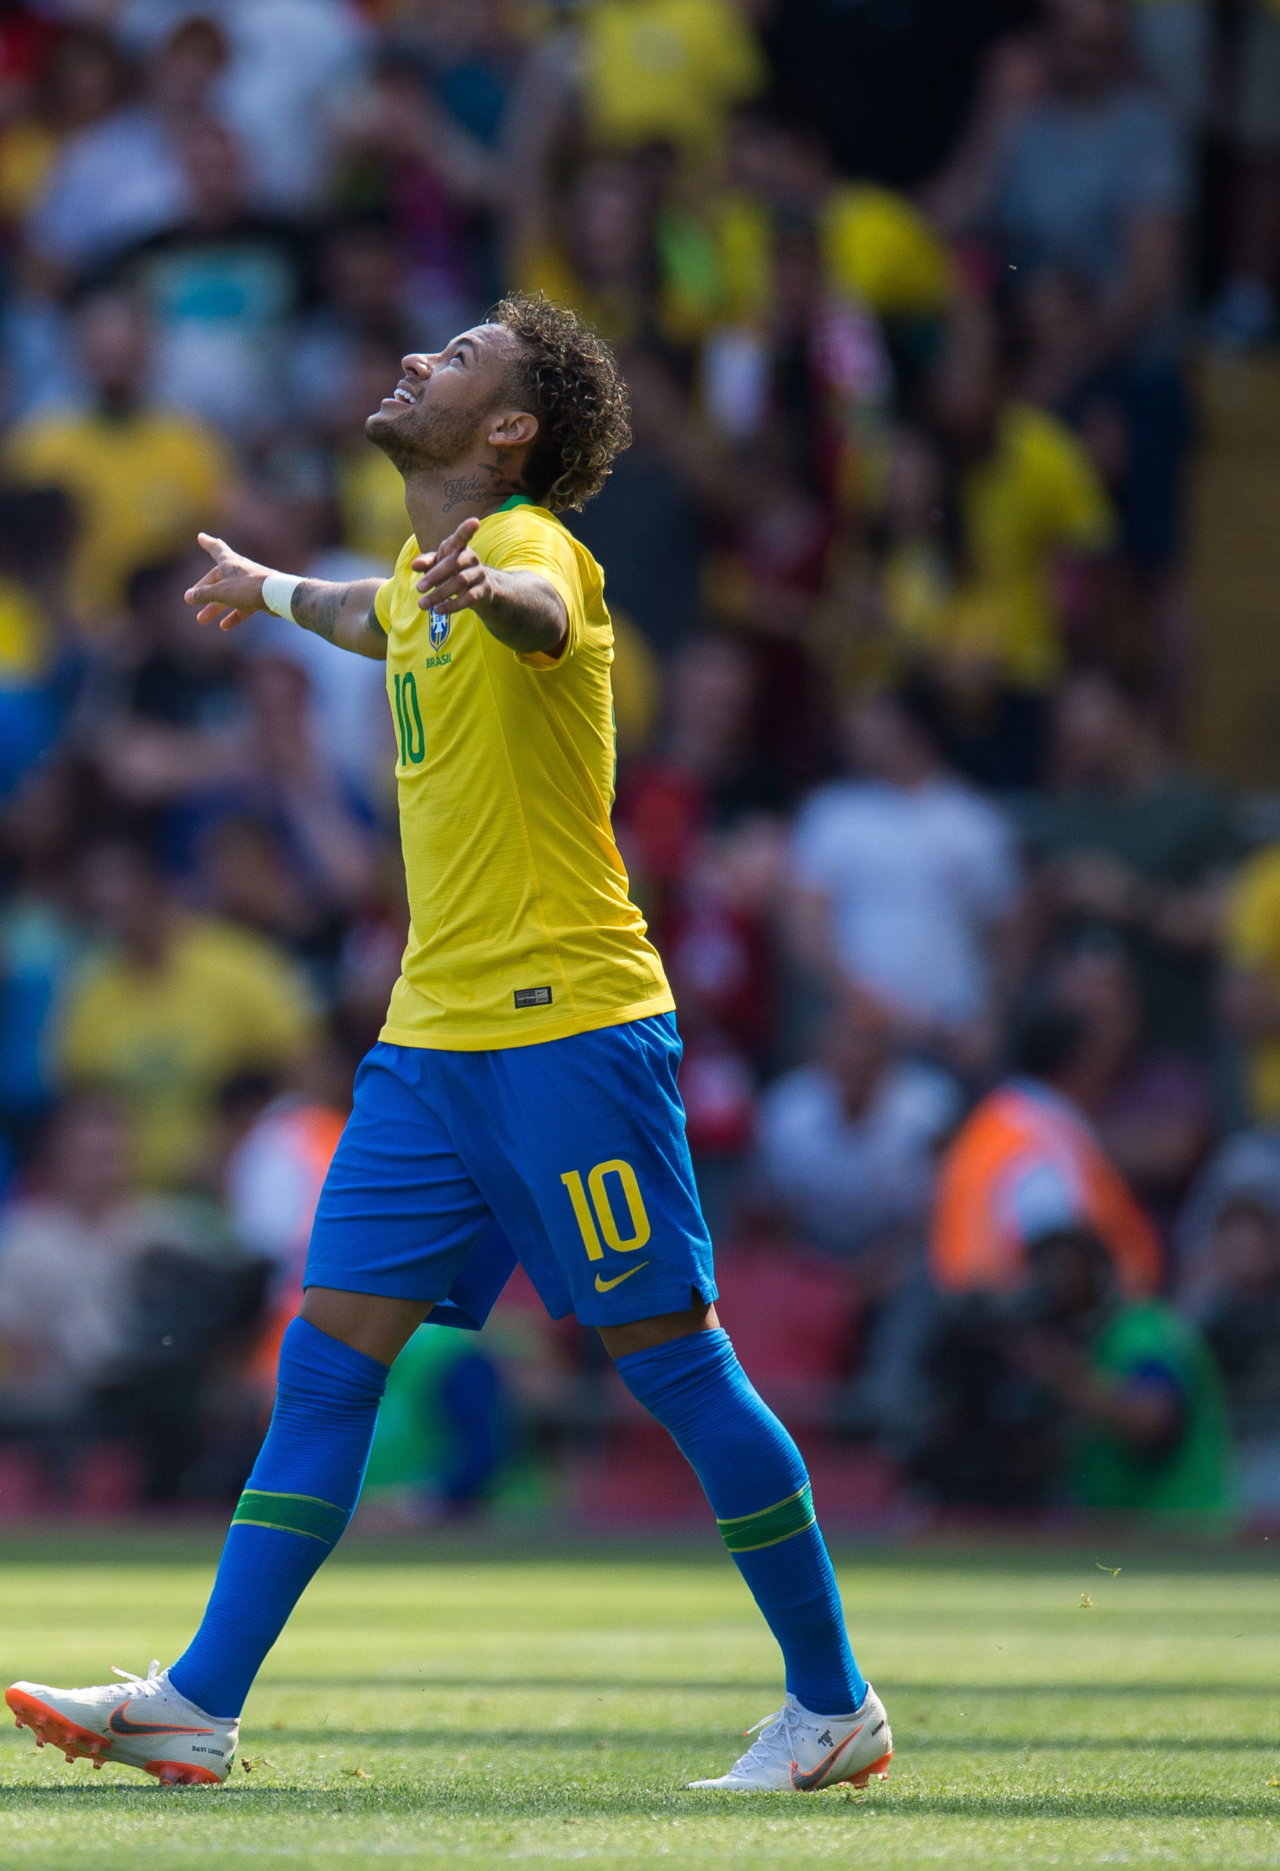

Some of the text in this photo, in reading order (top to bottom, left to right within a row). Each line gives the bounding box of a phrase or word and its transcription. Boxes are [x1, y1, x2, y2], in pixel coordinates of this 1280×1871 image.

[426, 653, 452, 668] BRASIL
[394, 671, 425, 766] 10
[560, 1159, 651, 1261] 10
